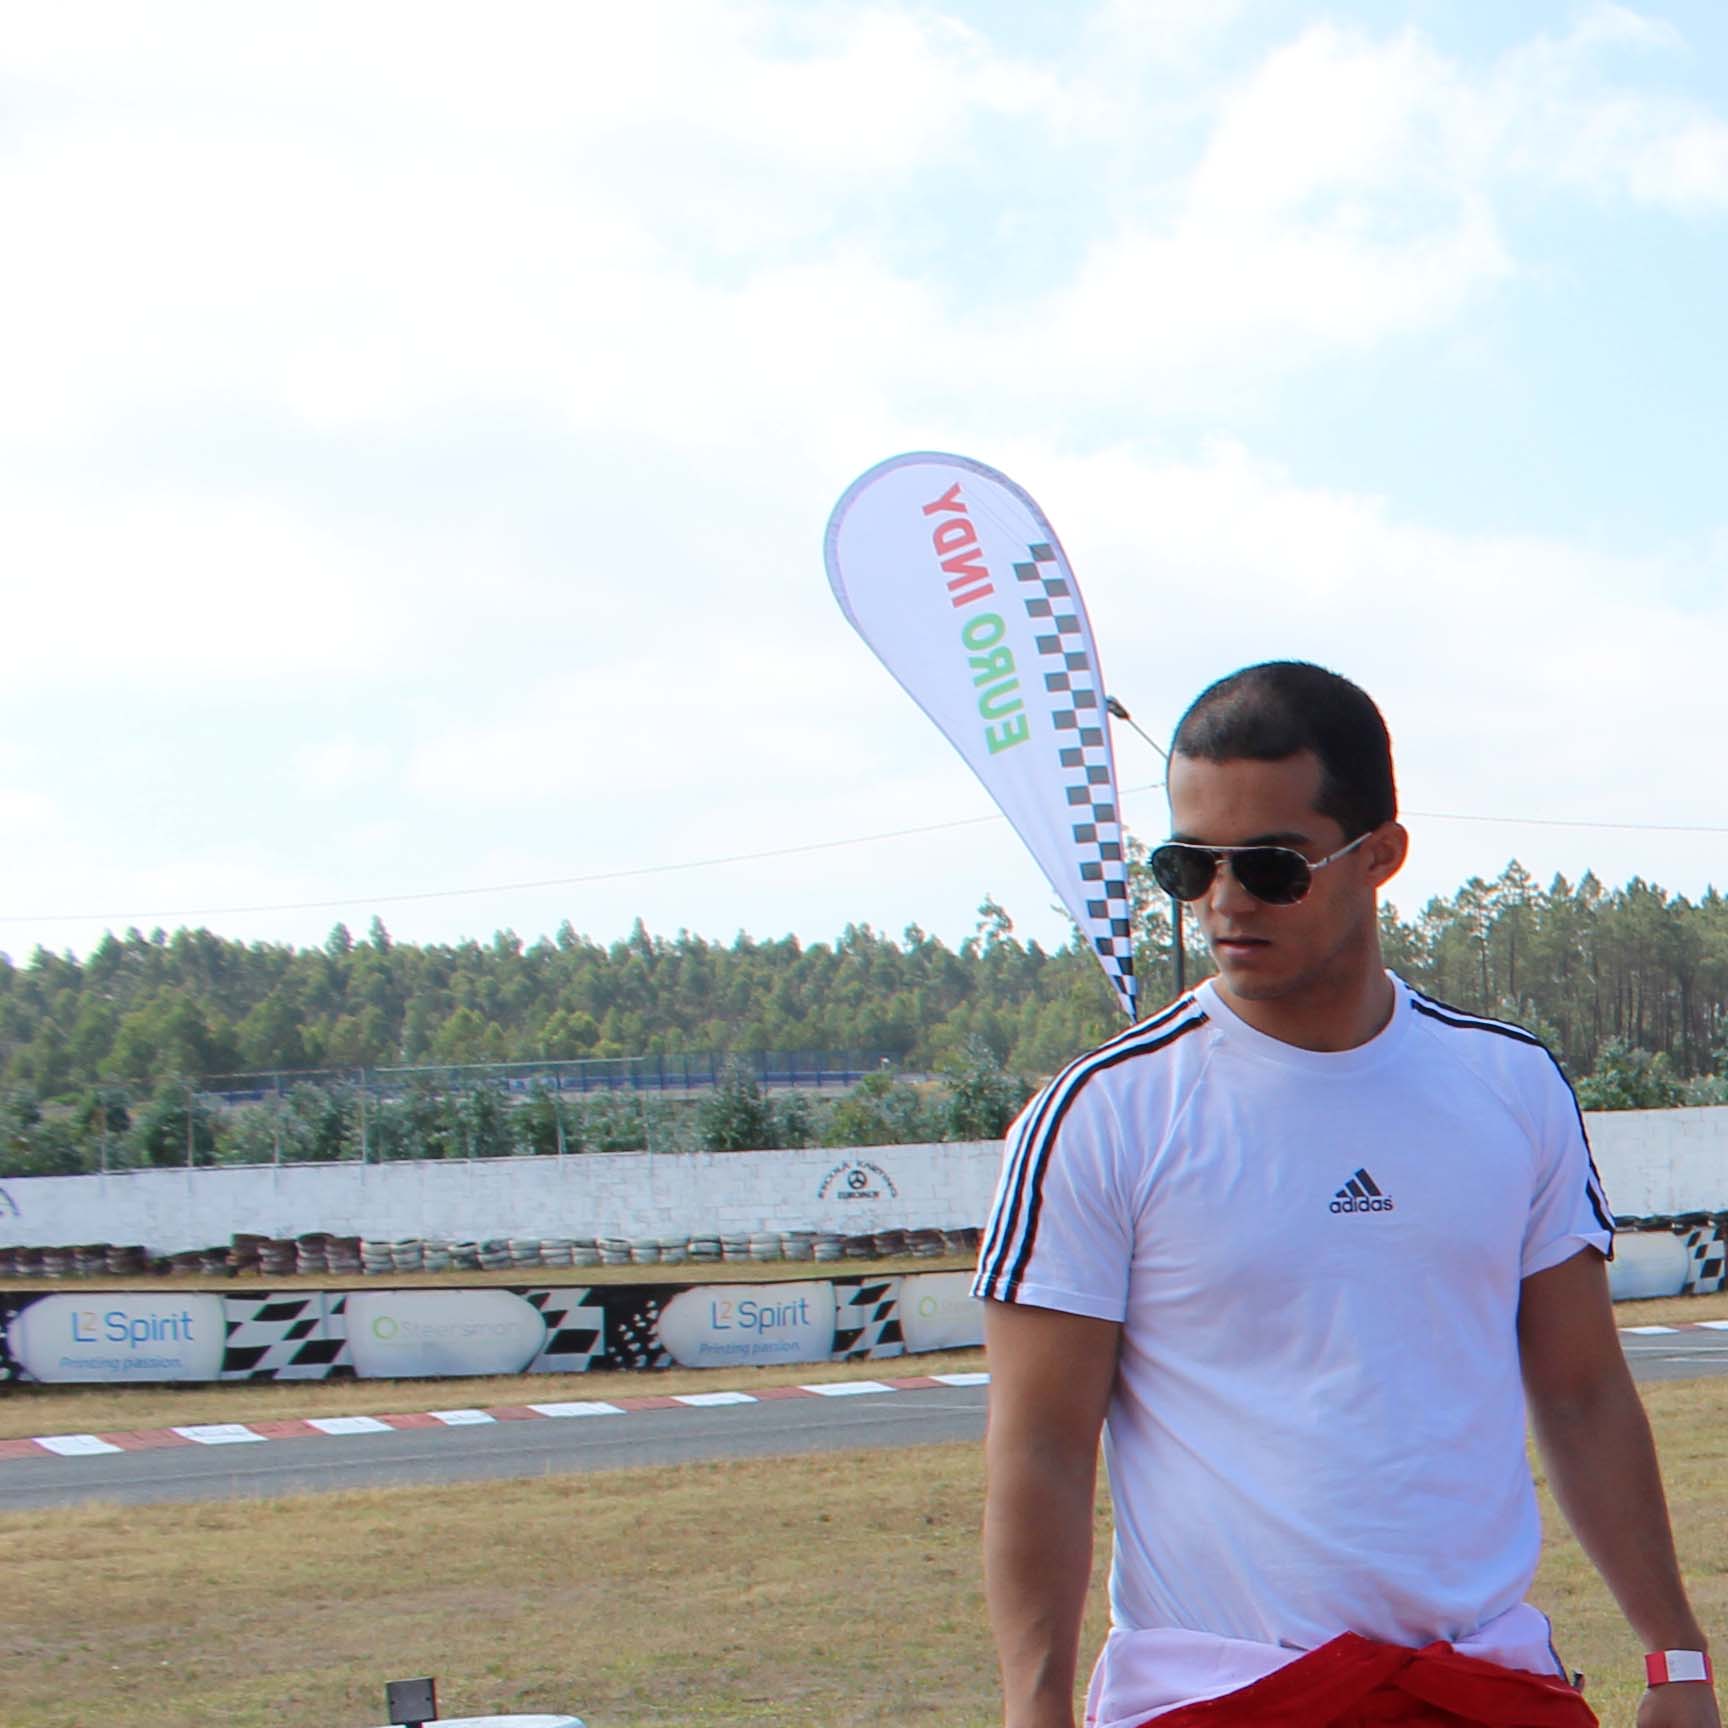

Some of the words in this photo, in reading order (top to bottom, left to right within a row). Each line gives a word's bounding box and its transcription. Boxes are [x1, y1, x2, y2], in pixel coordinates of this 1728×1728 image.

[1329, 1197, 1394, 1214] adidas
[104, 1310, 194, 1348] Spirit
[738, 1298, 809, 1335] Spirit
